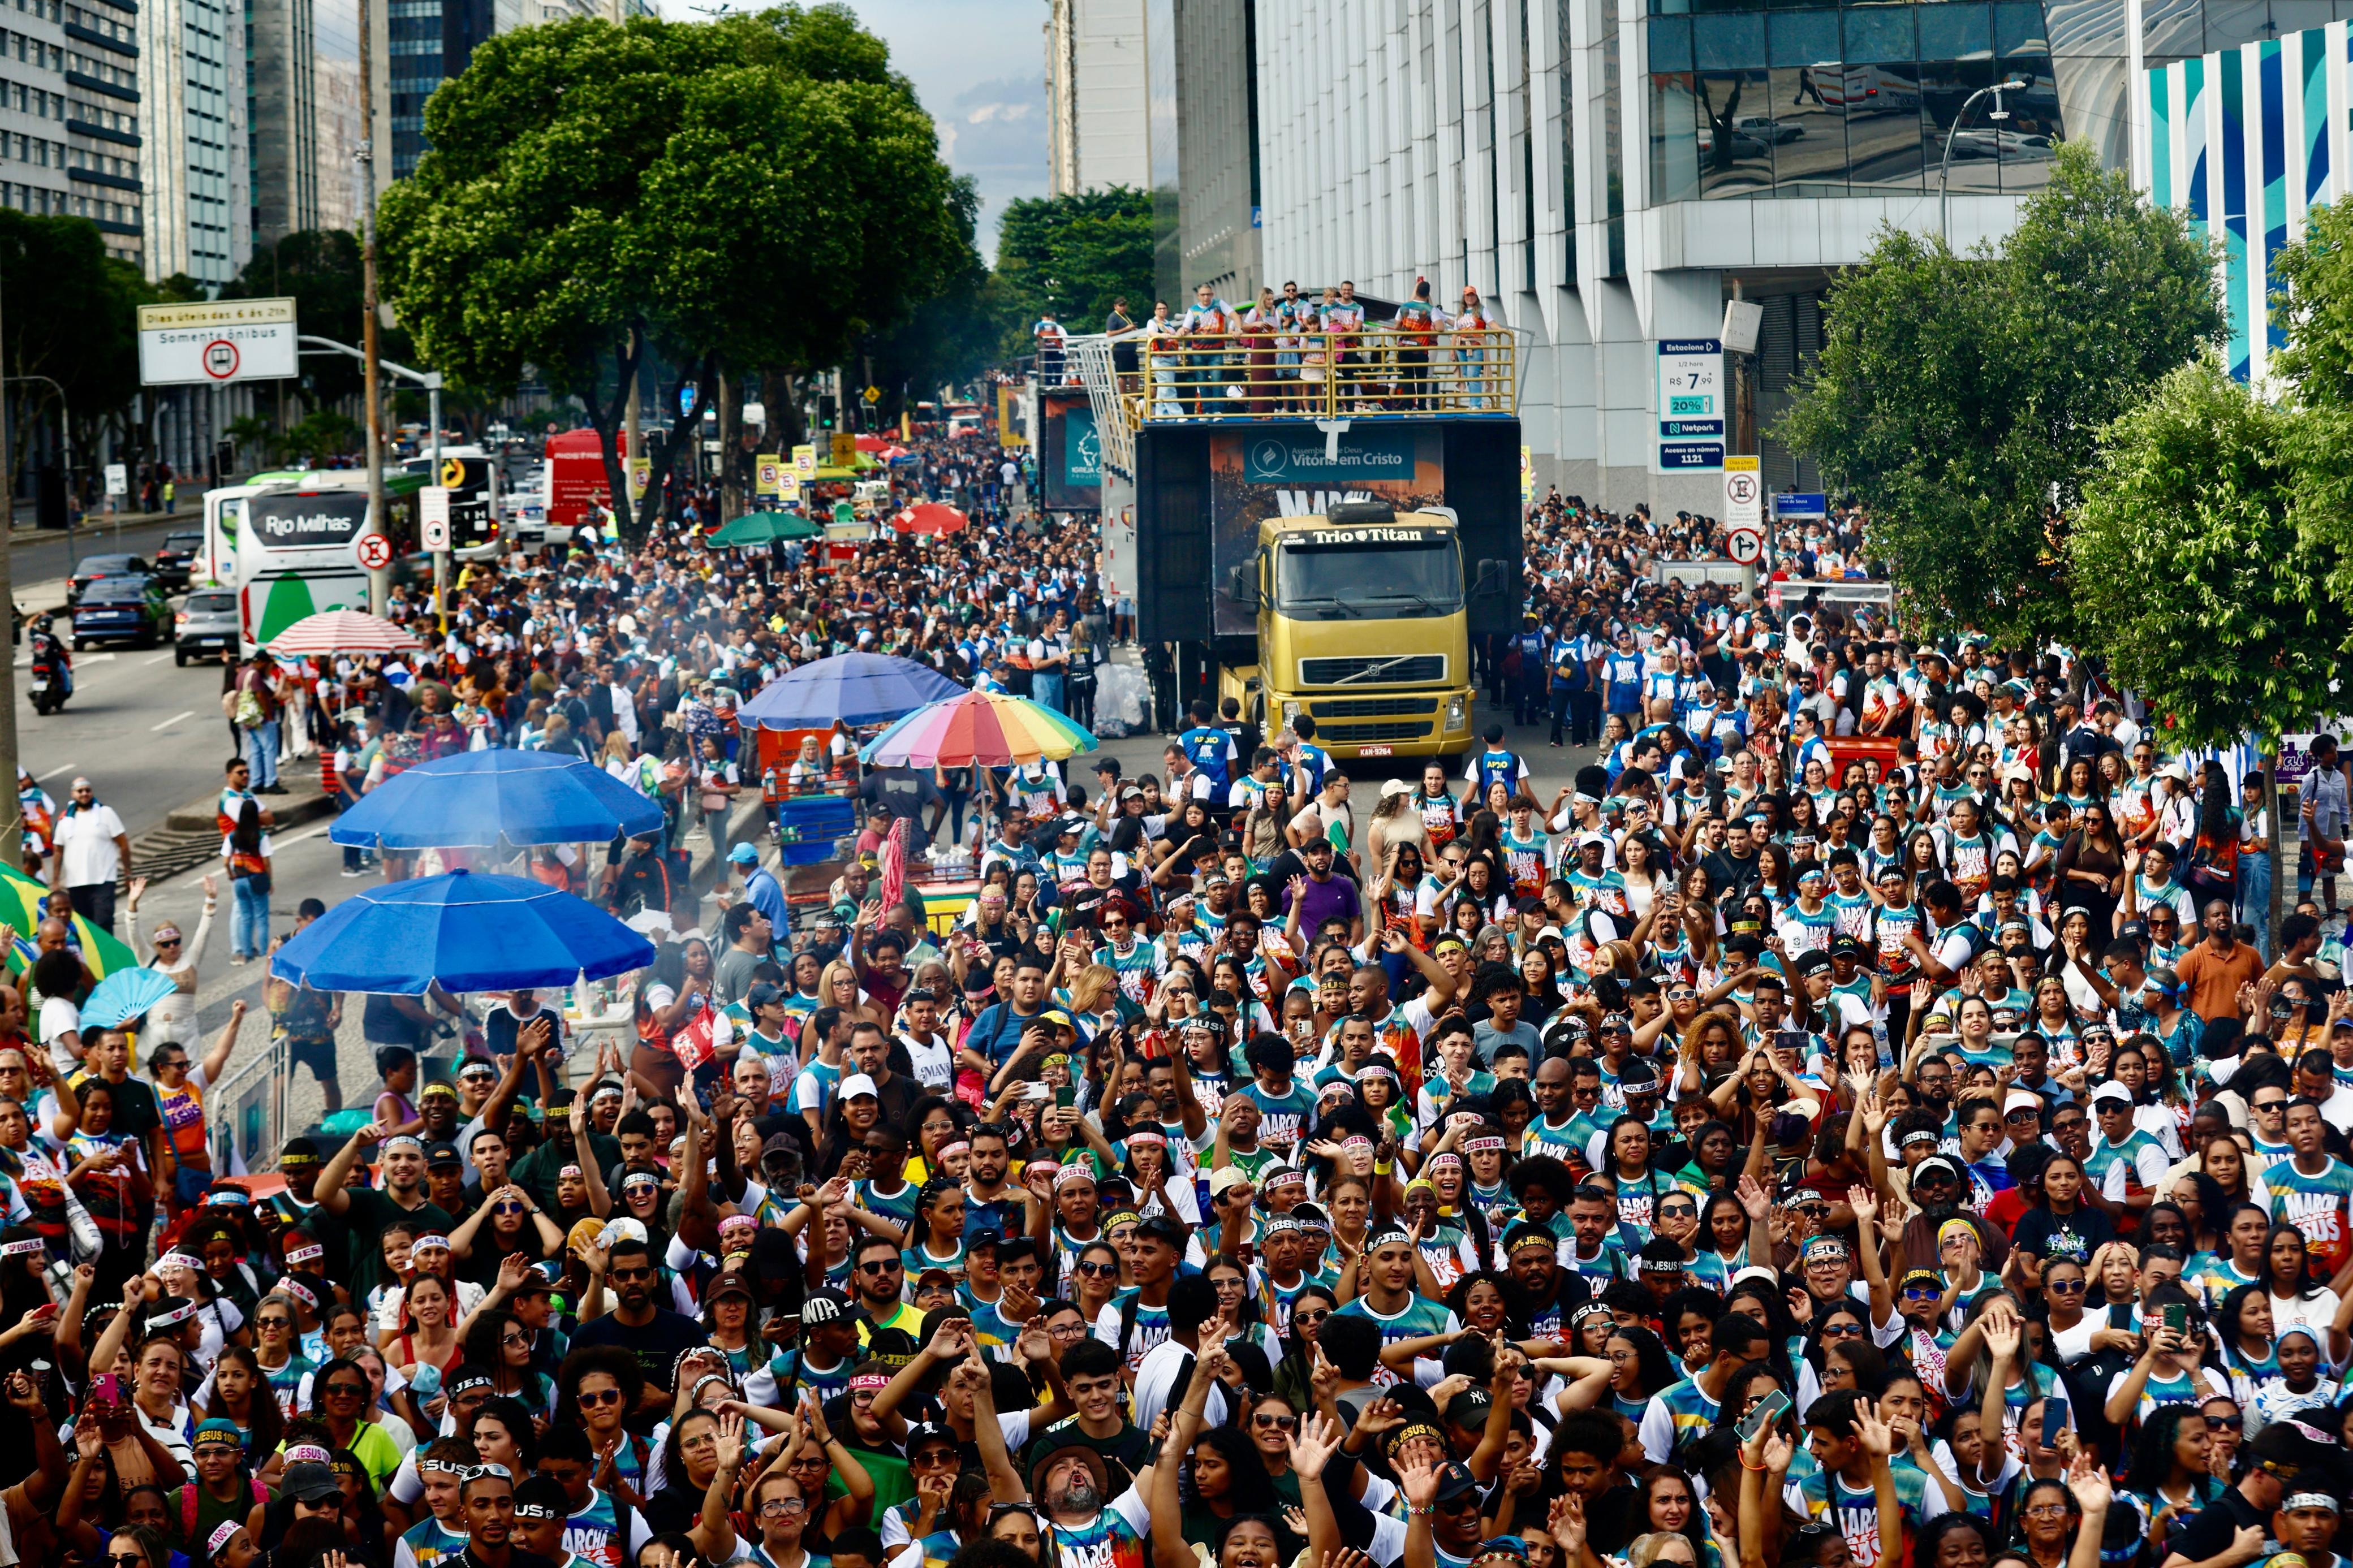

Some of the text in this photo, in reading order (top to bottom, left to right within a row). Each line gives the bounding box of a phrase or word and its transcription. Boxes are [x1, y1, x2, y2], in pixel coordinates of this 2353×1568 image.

[146, 314, 172, 323] Dias
[176, 310, 206, 322] úteis
[211, 310, 232, 320] das
[236, 308, 245, 318] 6
[267, 306, 287, 317] 21h
[160, 327, 277, 344] Somente ônibus
[1669, 378, 1682, 386] R$
[1672, 400, 1701, 412] 20%
[1682, 424, 1715, 433] Netpark
[1341, 455, 1362, 466] em
[1364, 452, 1403, 466] Cristo
[1681, 454, 1704, 464] 1121
[265, 513, 352, 537] Rio Milhas
[1312, 529, 1423, 543] Trio Titan
[1709, 570, 1742, 581] ESPECIA
[2082, 1025, 2110, 1038] JESUS
[1371, 1066, 1390, 1075] JESUS
[1319, 1083, 1352, 1097] JESUS
[1258, 1113, 1302, 1138] MARCHA
[1466, 1138, 1500, 1152] JESUS
[1901, 1130, 1936, 1148] JESUS
[1053, 1167, 1096, 1187] JESUS
[1785, 1193, 1801, 1209] 100%
[1302, 1219, 1326, 1229] JESUS
[1525, 1236, 1548, 1246] JESUS
[2050, 1240, 2084, 1251] FARM
[1654, 1260, 1677, 1271] JESUS
[1906, 1269, 1930, 1280] JESUS
[1916, 1332, 1946, 1373] 100% JESUS
[850, 1375, 891, 1386] JESU
[1469, 1390, 1487, 1404] NY
[197, 1430, 223, 1444] JESUS
[1399, 1424, 1427, 1441] JESUS
[295, 1446, 321, 1459] JESUS
[212, 1524, 233, 1545] 100%
